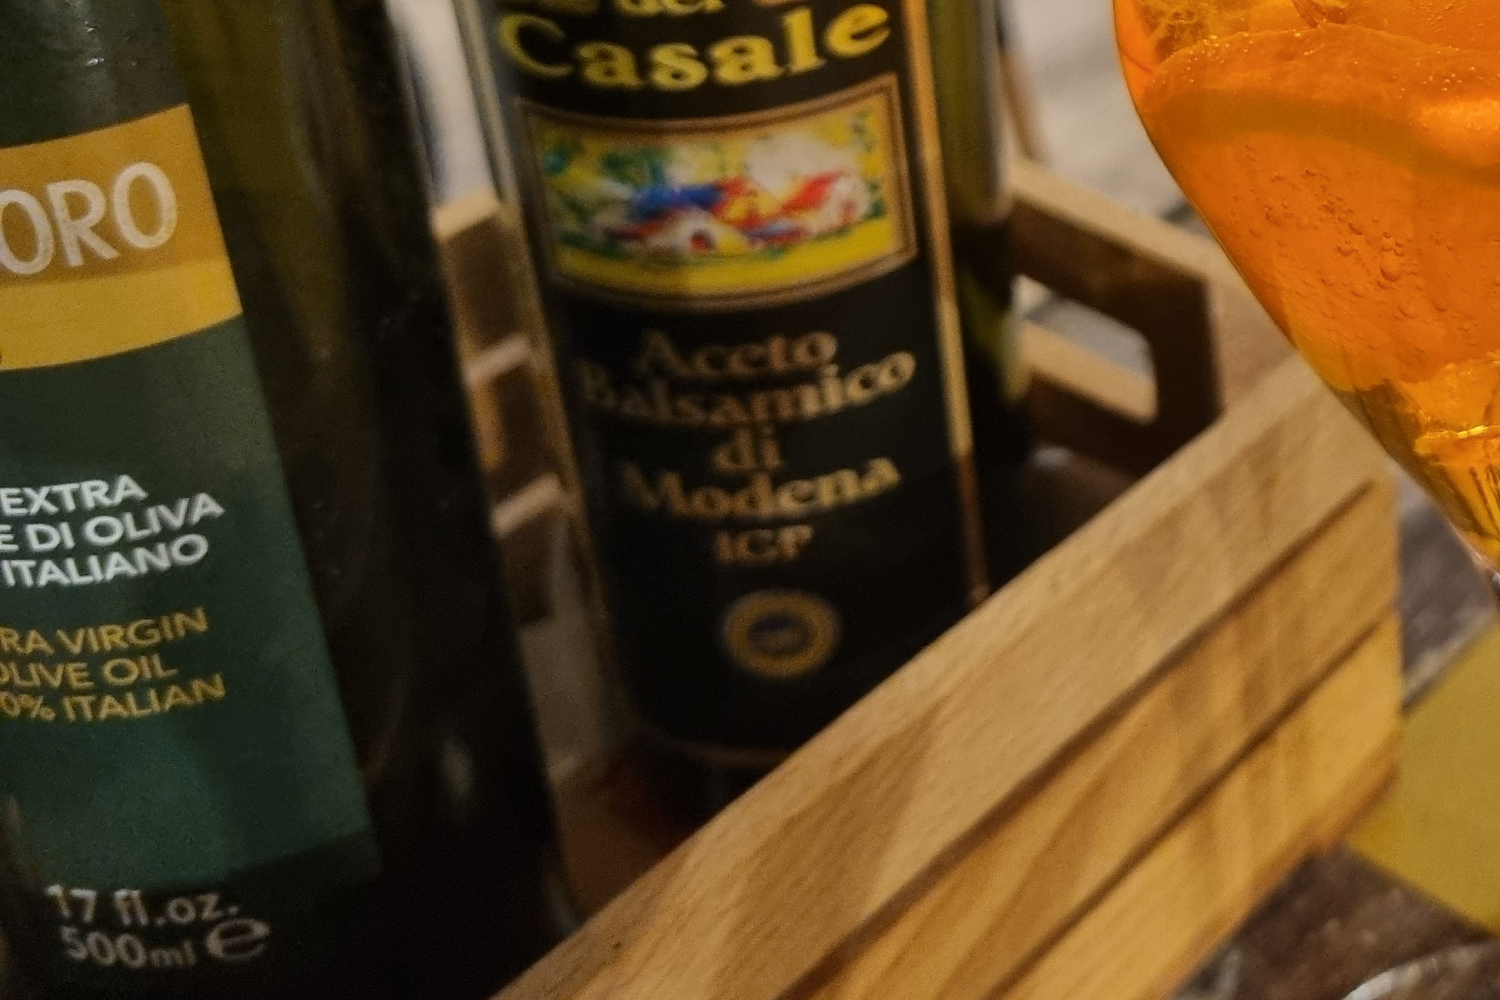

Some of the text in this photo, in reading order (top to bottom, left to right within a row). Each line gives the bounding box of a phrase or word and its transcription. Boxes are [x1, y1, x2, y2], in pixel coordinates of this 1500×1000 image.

[501, 3, 891, 91] Casale
[575, 352, 916, 424] Balsamico
[712, 424, 782, 473] di
[0, 474, 149, 517] EXTRA
[620, 457, 900, 518] Modena
[25, 521, 76, 552] DI
[83, 492, 226, 547] OLIVA
[0, 533, 209, 588] ITALIANO
[58, 605, 210, 655] VIRGIN
[102, 652, 180, 688] OIL
[62, 672, 228, 723] ITALIAN
[46, 884, 98, 924] 17
[60, 922, 198, 969] 500ml
